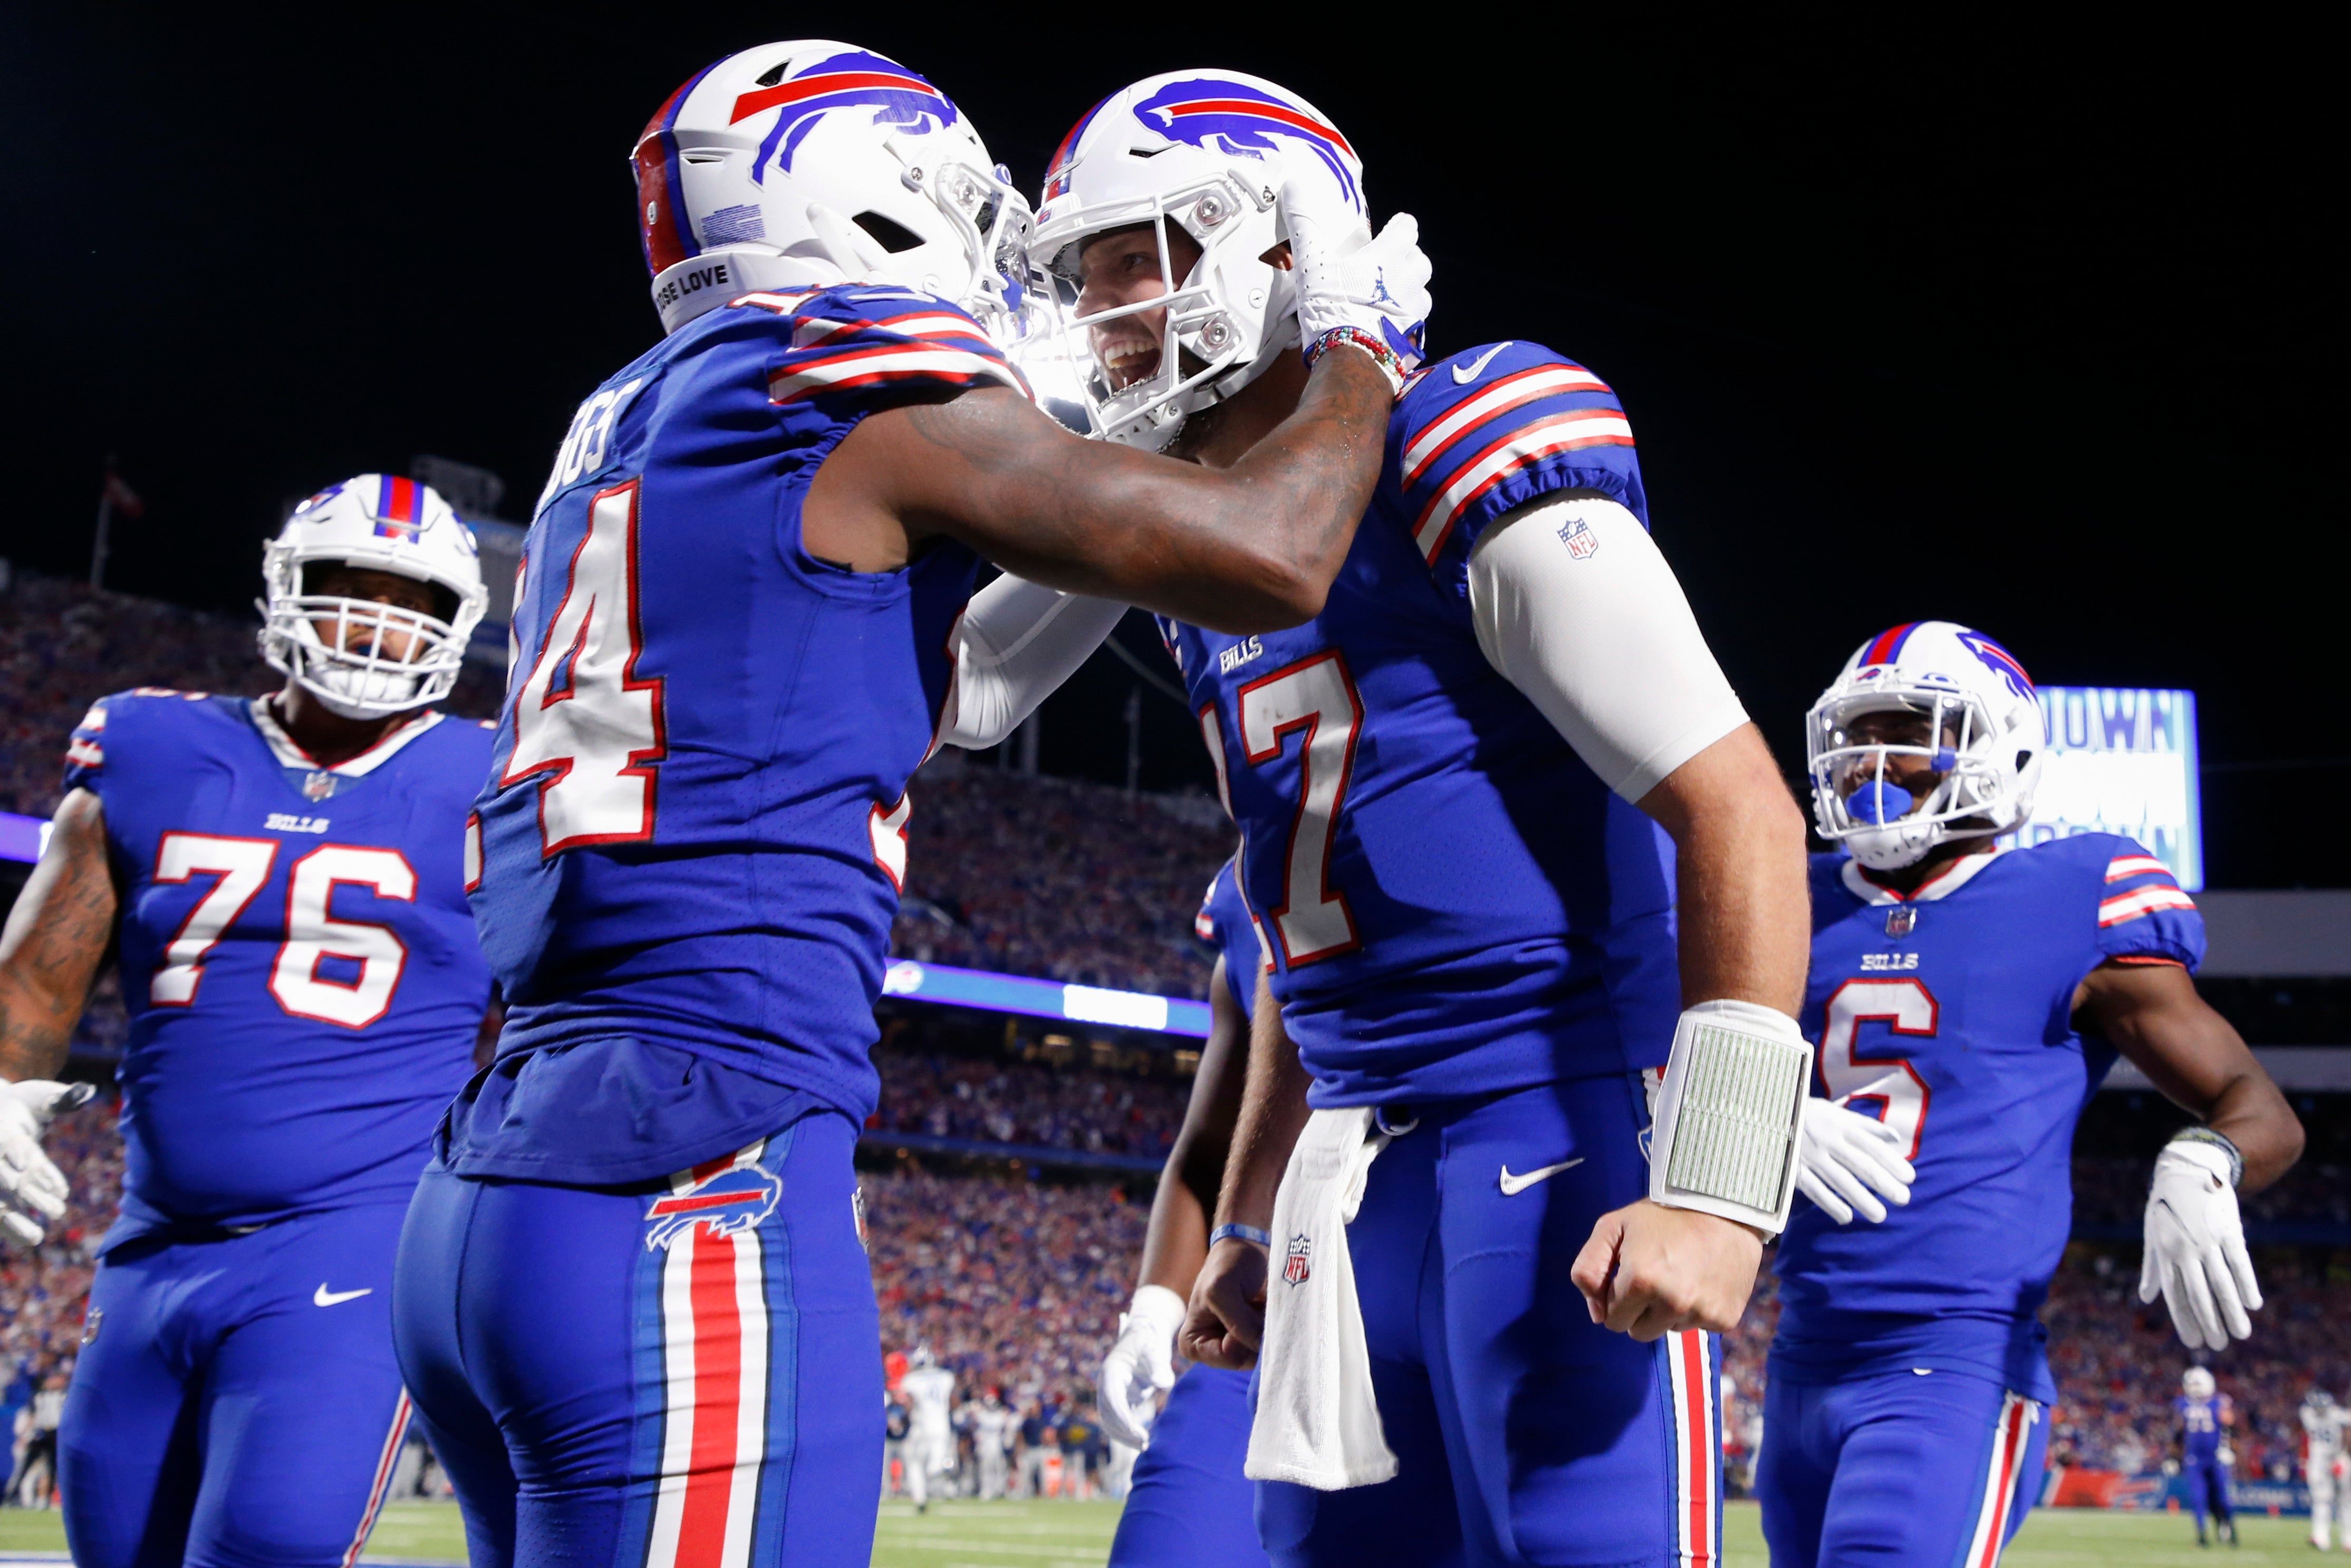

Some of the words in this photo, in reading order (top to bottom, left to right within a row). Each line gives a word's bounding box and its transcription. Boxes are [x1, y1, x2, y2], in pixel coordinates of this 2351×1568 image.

[678, 264, 729, 295] LOVE
[1567, 532, 1595, 556] NFL
[1219, 634, 1264, 676] BILLS
[150, 830, 418, 1031] 76
[1859, 953, 1920, 971] BILLS
[1818, 977, 1939, 1160] 6
[1286, 1256, 1309, 1282] NFL
